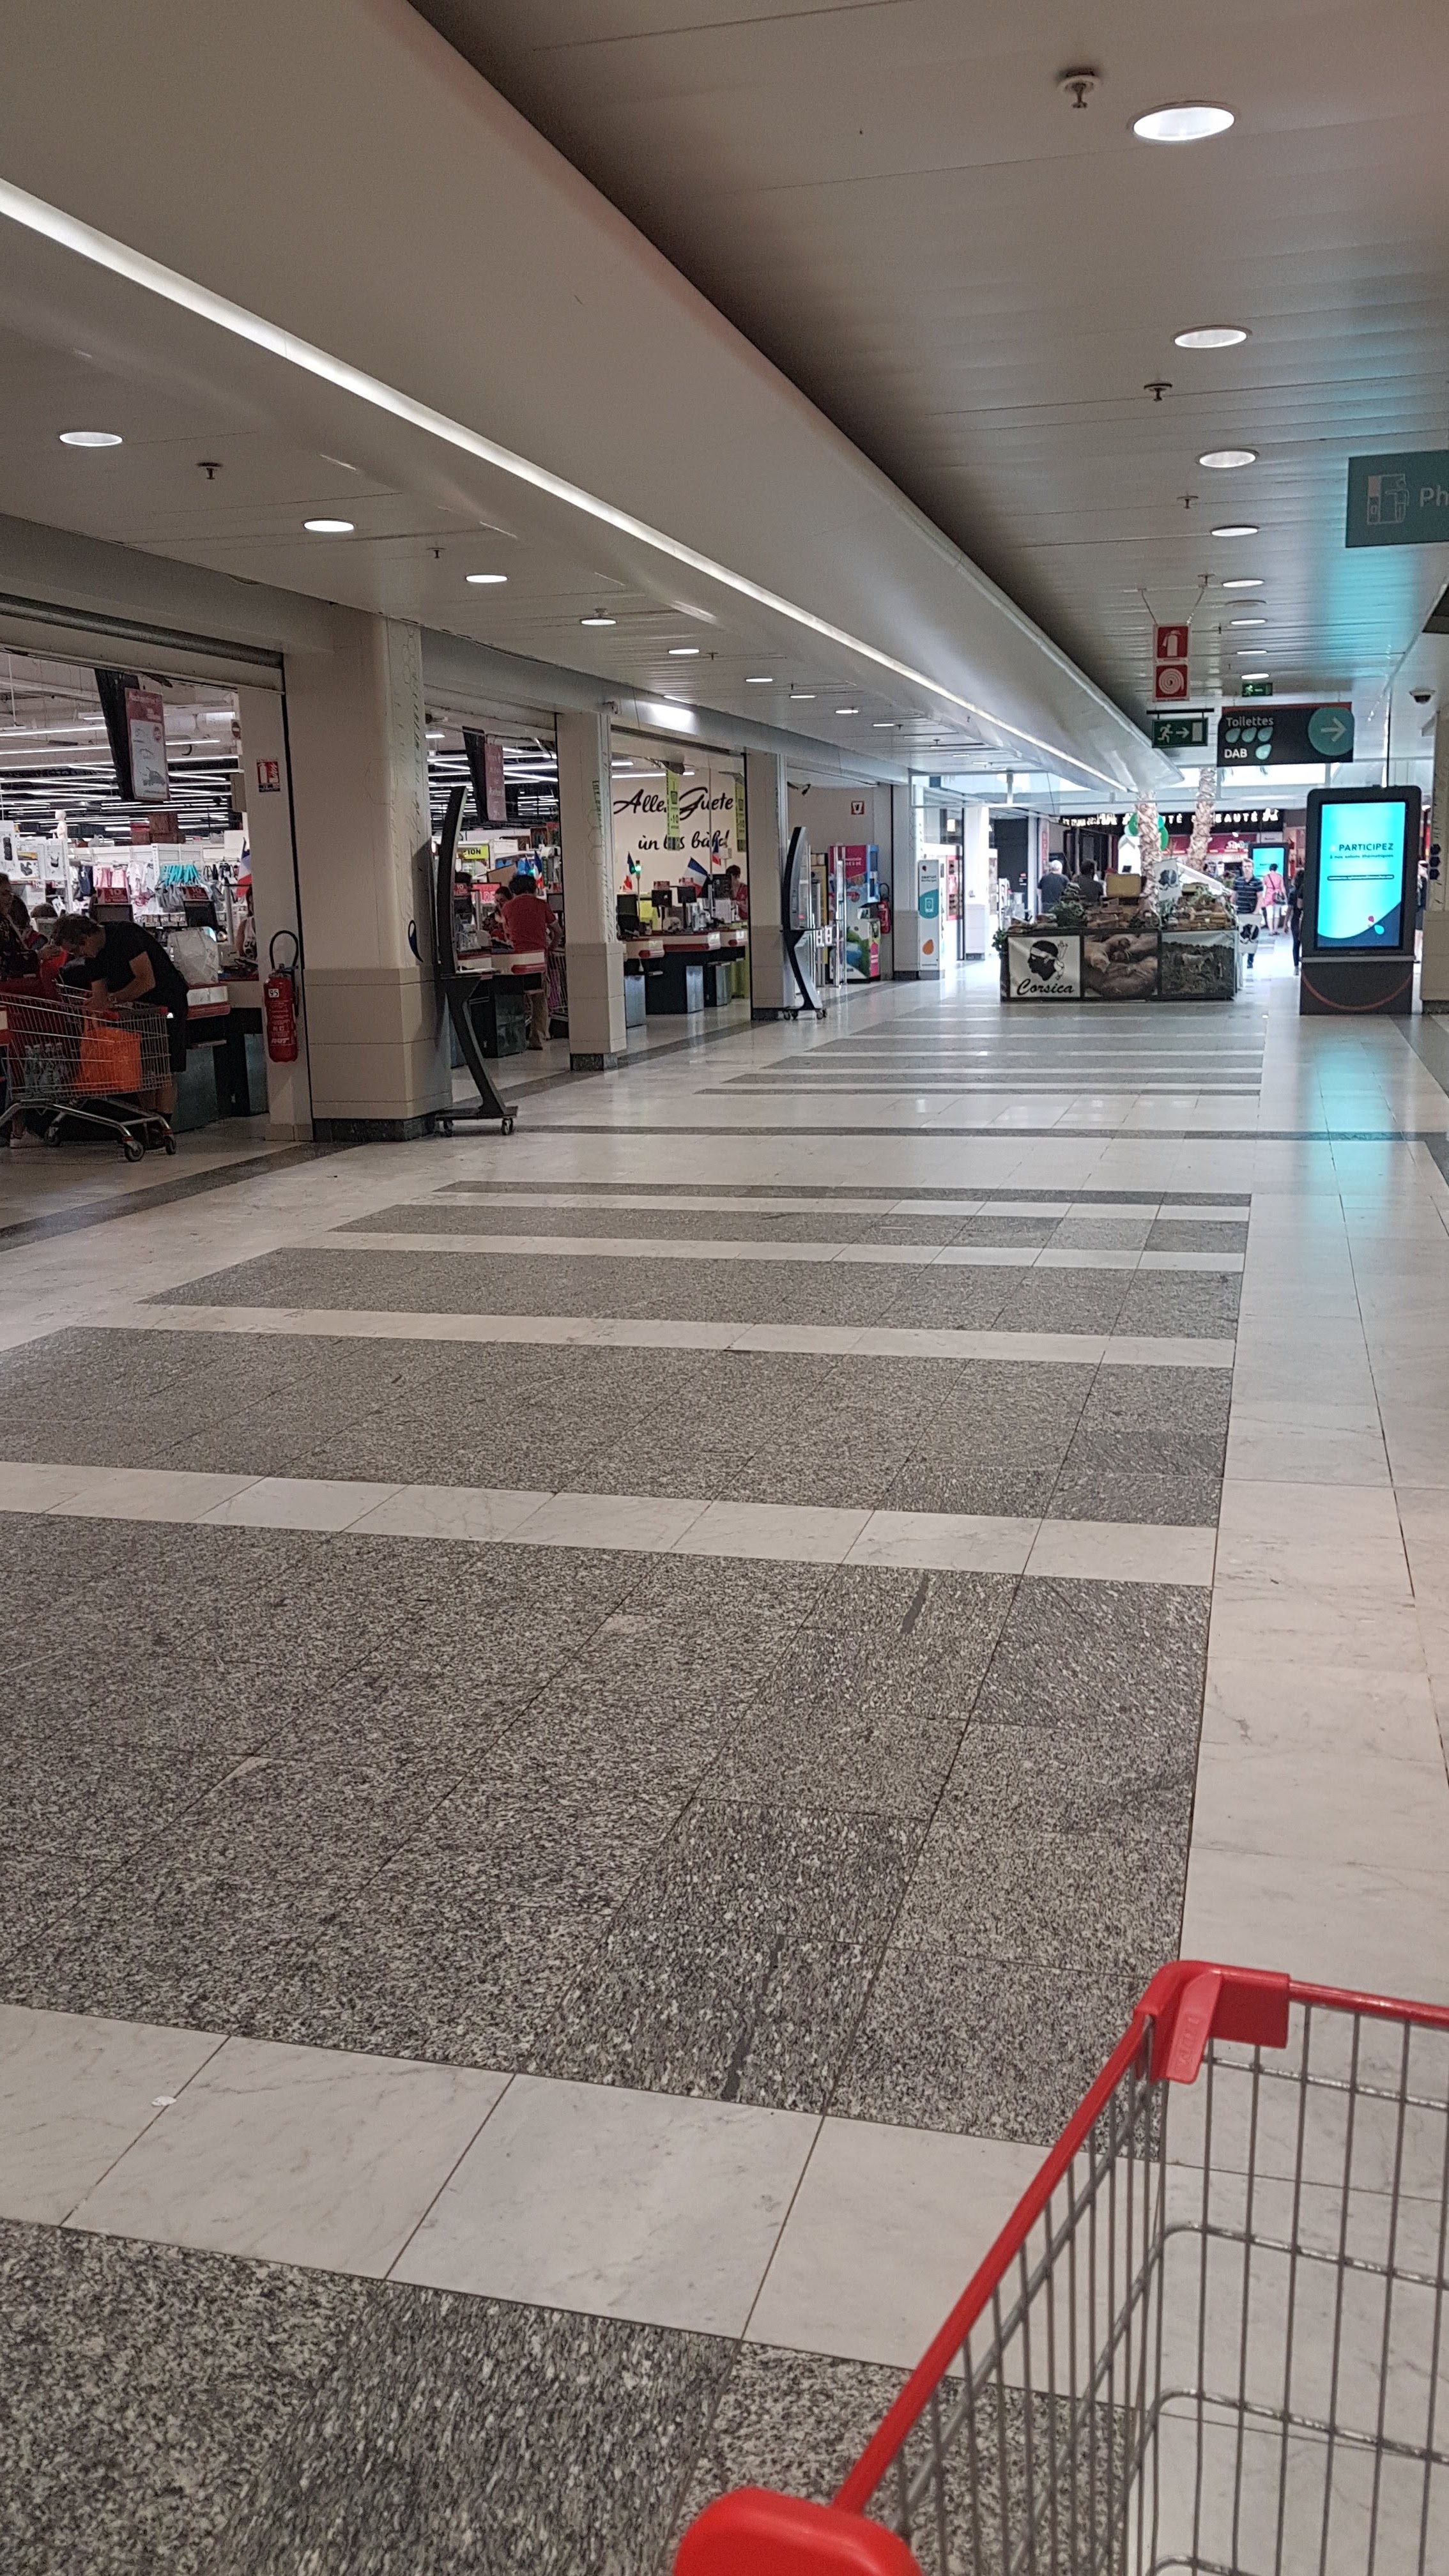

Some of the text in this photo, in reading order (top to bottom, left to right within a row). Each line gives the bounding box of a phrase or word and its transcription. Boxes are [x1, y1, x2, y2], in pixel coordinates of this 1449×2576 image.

[1226, 716, 1274, 727] Toilettes
[1224, 748, 1247, 758] DAB
[1339, 843, 1393, 851] PARTICIPEZ
[1016, 978, 1074, 995] Corsica
